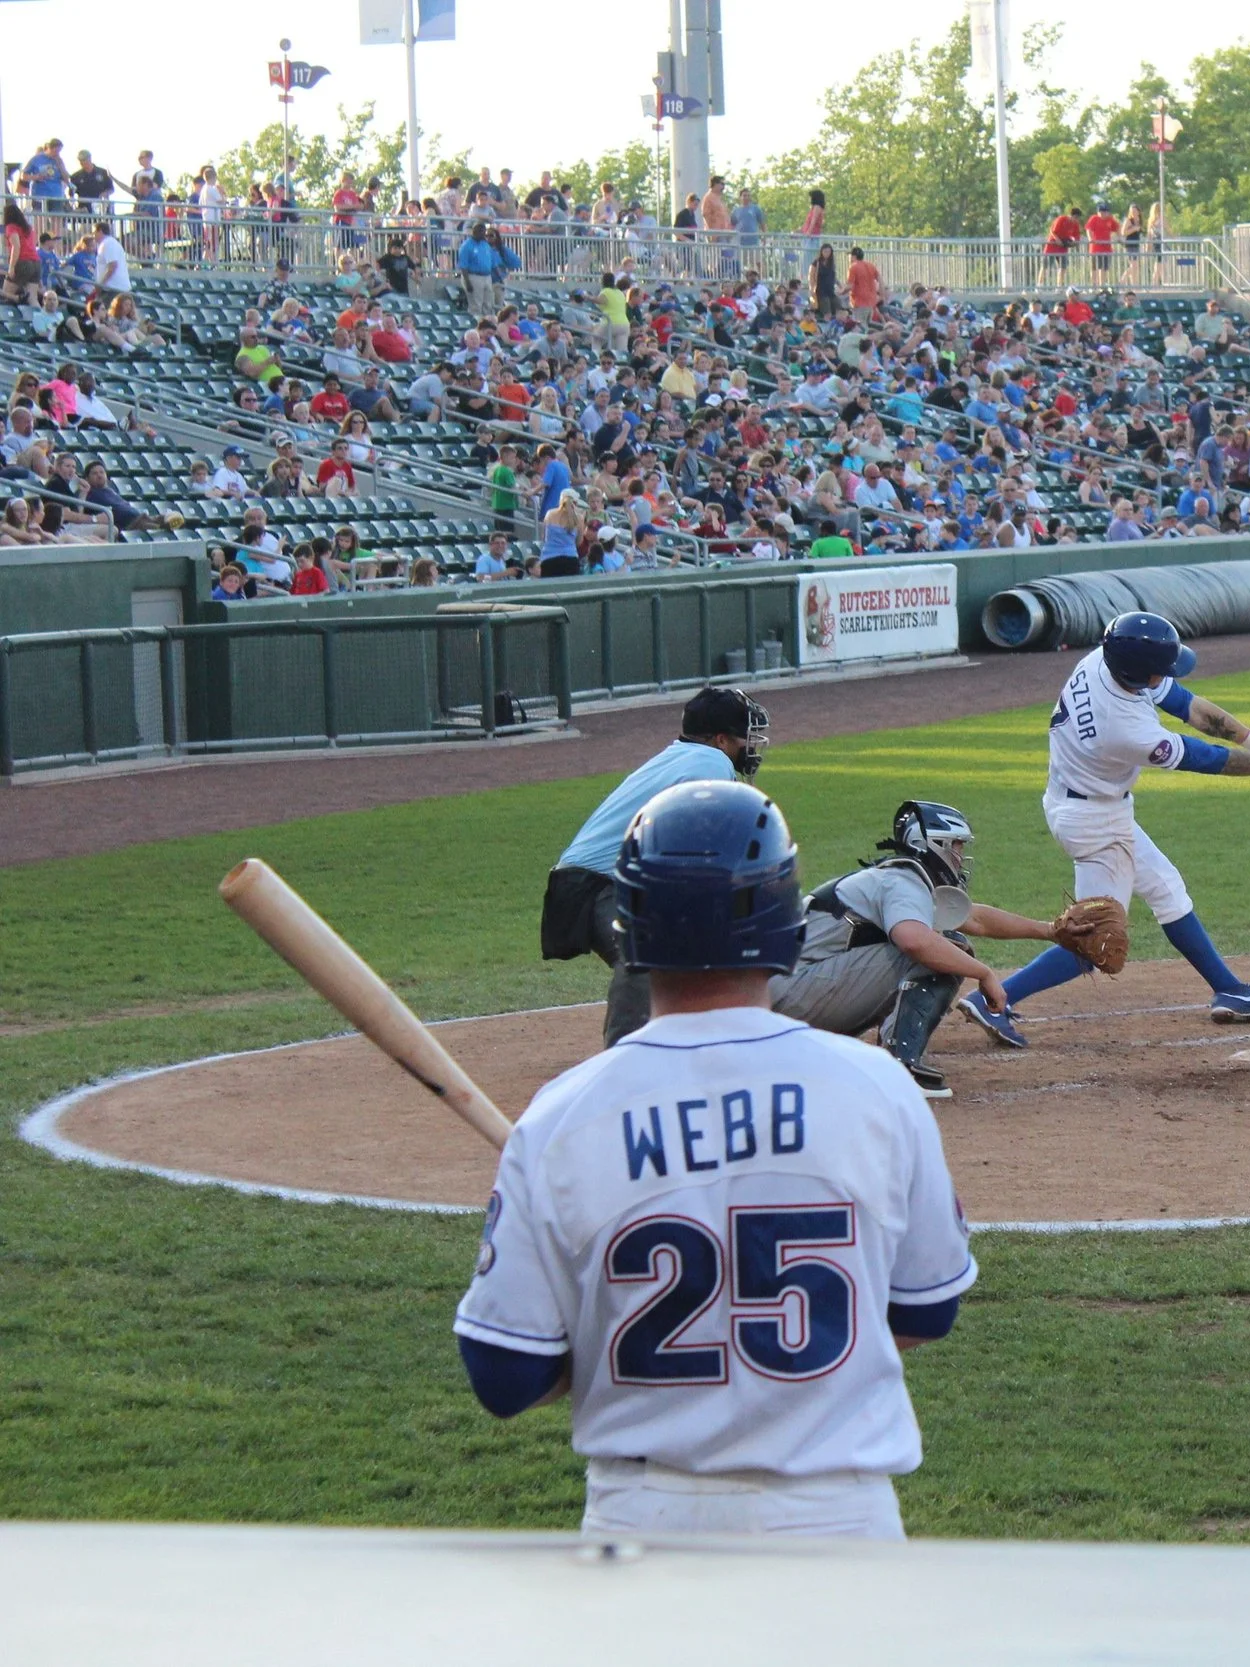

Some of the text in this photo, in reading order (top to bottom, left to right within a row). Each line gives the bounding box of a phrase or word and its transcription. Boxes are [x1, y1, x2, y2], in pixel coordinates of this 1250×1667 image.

[294, 68, 311, 83] 117
[665, 100, 683, 113] 118
[840, 586, 950, 613] RUTGERS FOOTBALL
[840, 611, 938, 634] SCARLETKNIGHTS.COM
[622, 1083, 805, 1181] WEBB
[605, 1202, 856, 1386] 25
